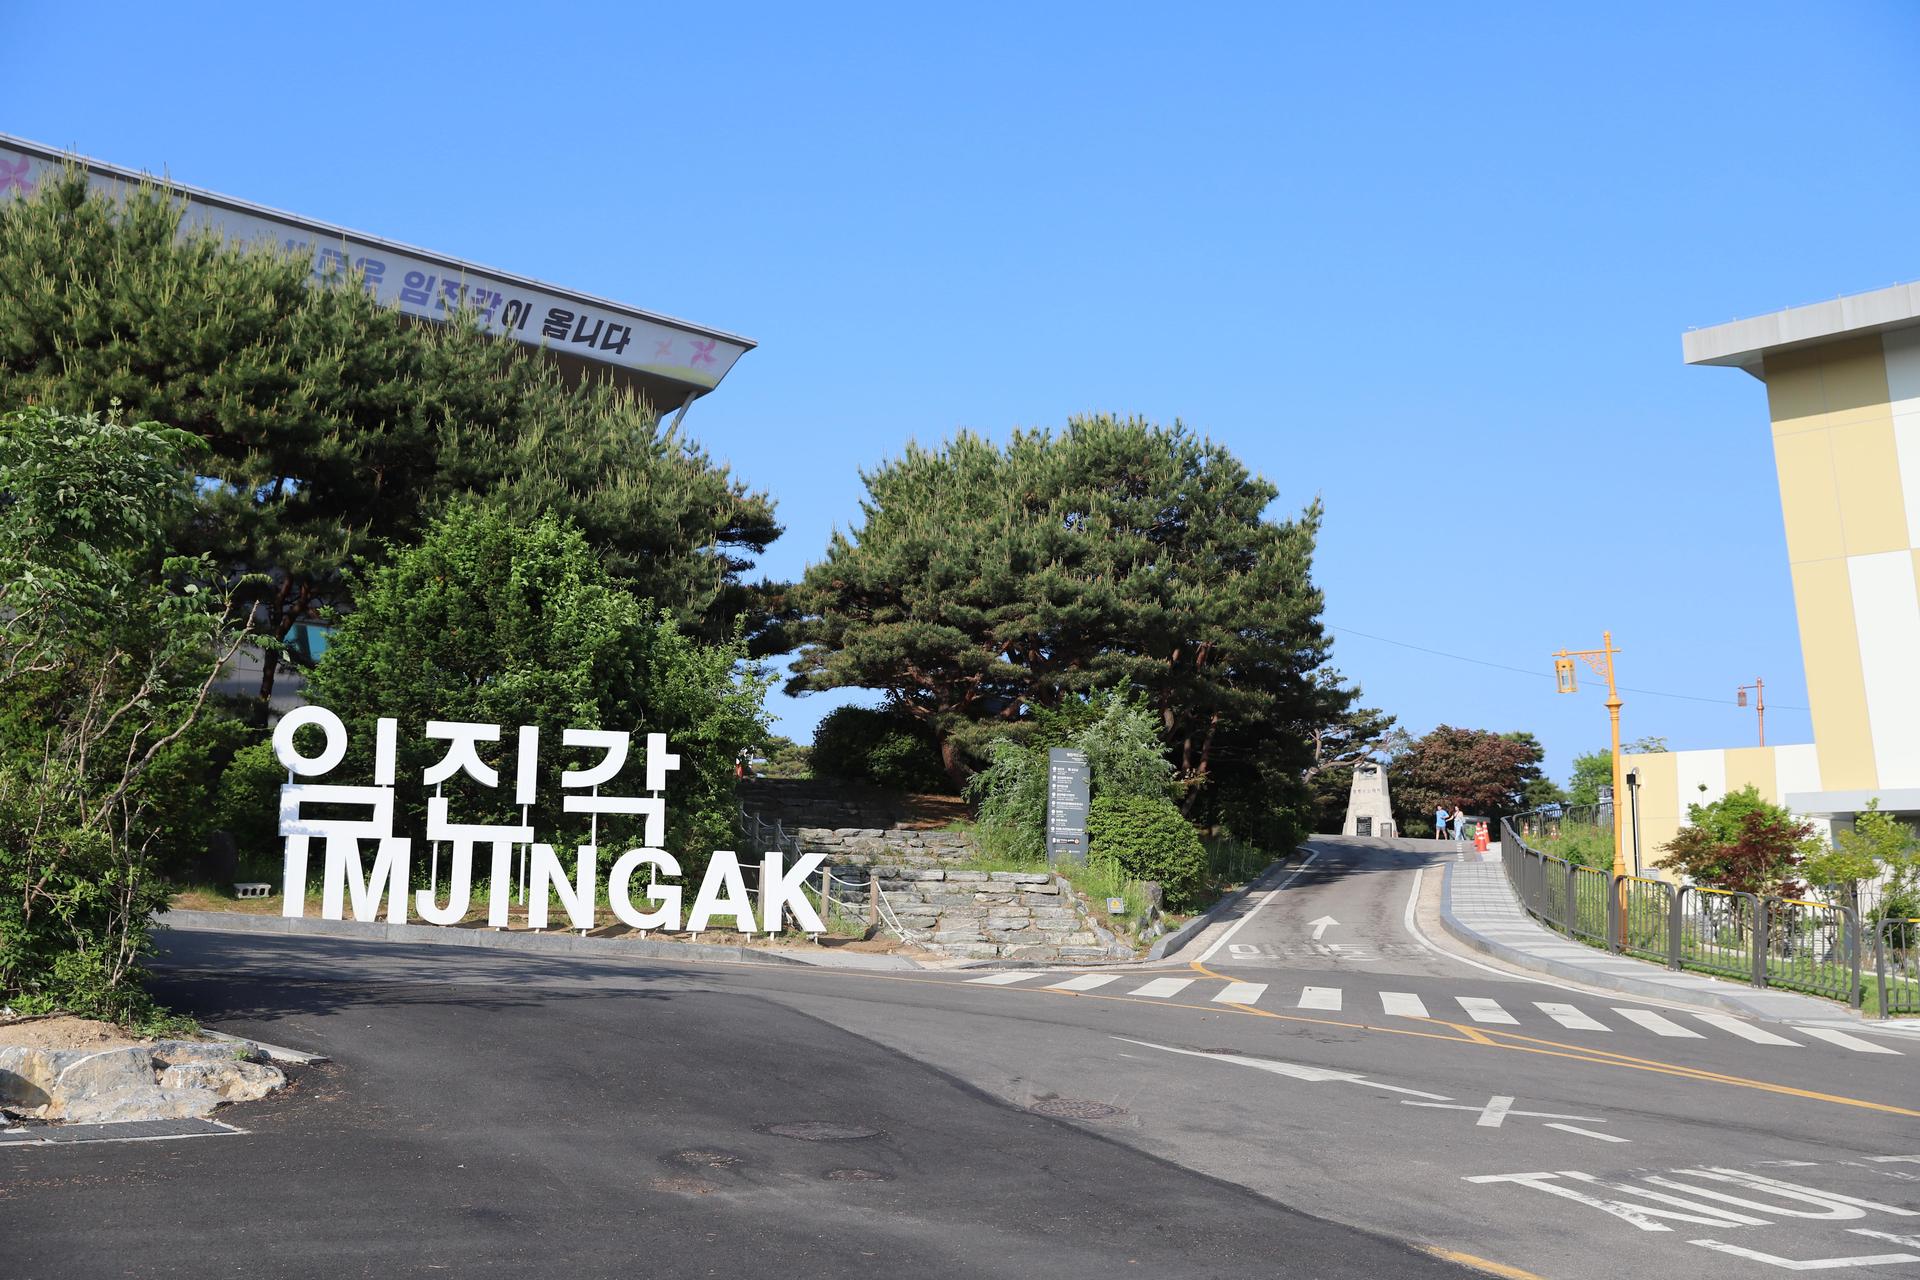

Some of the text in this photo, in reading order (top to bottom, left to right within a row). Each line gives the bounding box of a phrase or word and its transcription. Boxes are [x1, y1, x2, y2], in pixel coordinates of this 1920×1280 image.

[400, 271, 533, 329] 임진각이
[543, 307, 632, 355] 옵니다
[272, 705, 681, 847] 임진각
[282, 834, 829, 934] IMJINGAK
